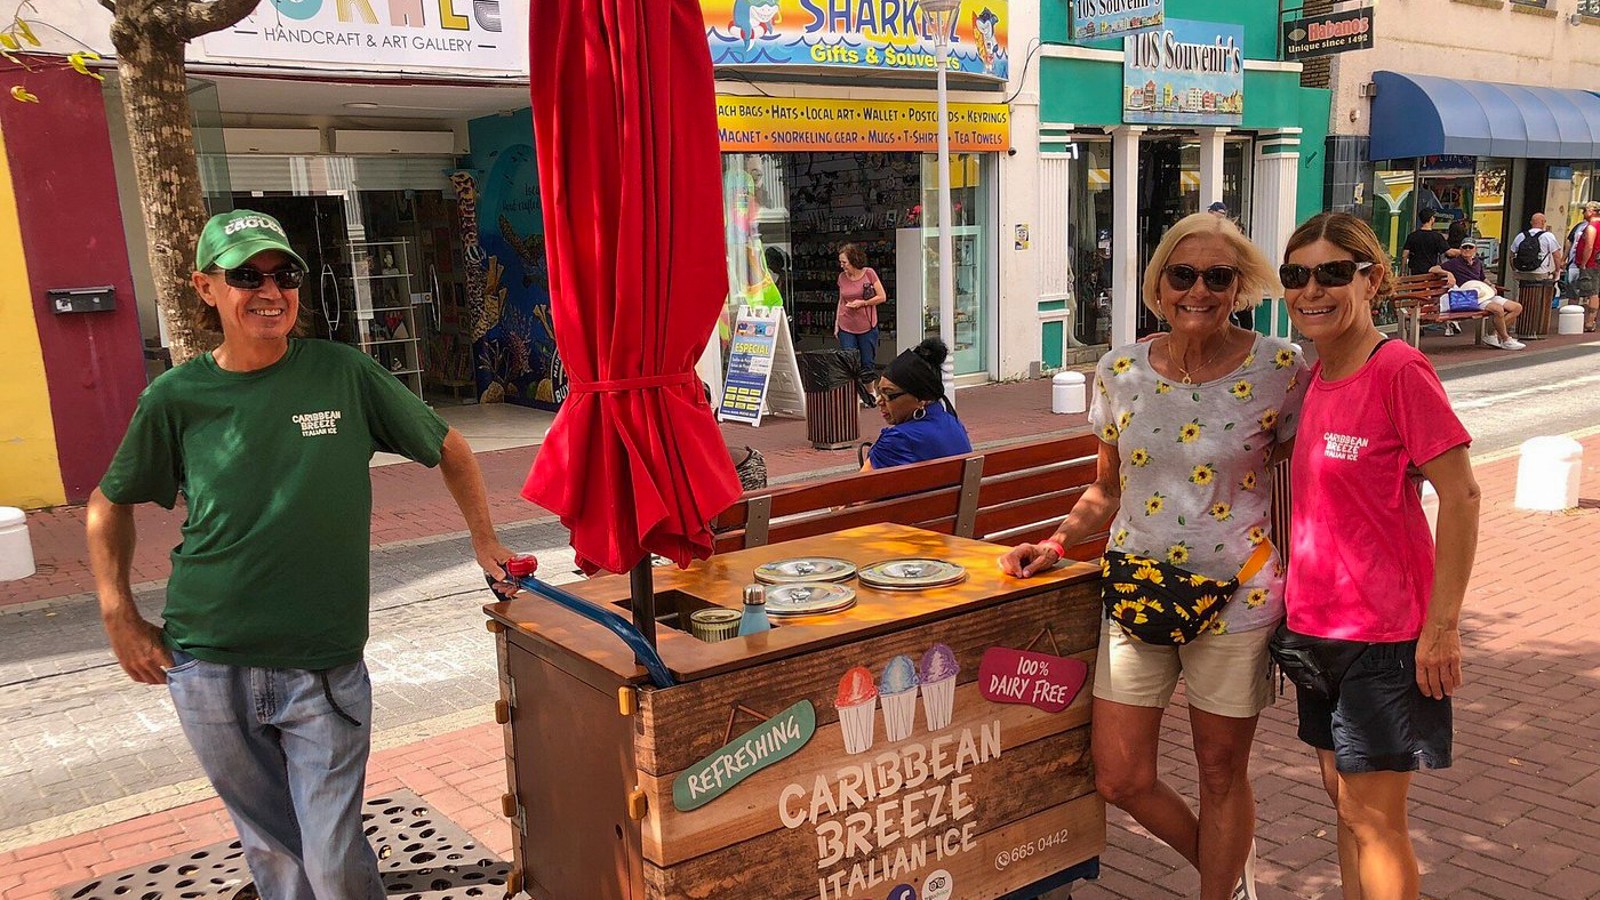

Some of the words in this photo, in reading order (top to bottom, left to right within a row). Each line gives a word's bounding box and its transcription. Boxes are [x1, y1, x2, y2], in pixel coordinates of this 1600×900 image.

[801, 0, 959, 42] SHARKEZ
[1308, 17, 1369, 41] Habanos
[264, 28, 360, 46] HANDCRAFT
[366, 34, 378, 48] &
[382, 36, 408, 48] ART
[412, 36, 472, 52] GALLERY
[1288, 43, 1320, 53] Unique
[1322, 38, 1345, 48] since
[1348, 34, 1368, 44] 1492
[810, 44, 859, 64] Gifts
[865, 47, 879, 65] &
[885, 48, 960, 70] Souvers
[1130, 32, 1160, 69] 10S
[1163, 31, 1240, 74] Souvenir's
[718, 105, 737, 117] ACH
[740, 105, 763, 117] BAGS
[771, 104, 799, 120] HATS
[805, 106, 834, 120] LOCAL
[836, 108, 855, 120] ART
[863, 107, 899, 121] WALLET
[908, 108, 960, 122] POSTCDS
[967, 110, 1007, 123] KEYRINGS
[718, 128, 761, 143] MAGNET
[771, 130, 832, 144] SNORKELING
[834, 131, 858, 144] GEAR
[868, 130, 895, 144] MUGS
[954, 131, 970, 144] TEA
[972, 131, 1003, 145] TOWELS
[735, 342, 769, 355] ESPECIAL
[292, 411, 341, 424] CARIBBEAN
[301, 419, 337, 430] BREEZE
[302, 429, 327, 437] ITALIAN
[1323, 431, 1369, 447] CARIBBEAN
[1325, 449, 1346, 460] ITALIAN
[1347, 453, 1359, 461] ICE
[1326, 441, 1360, 454] BREEZE
[1017, 656, 1049, 677] 100%
[989, 674, 1030, 699] DAIRY
[1032, 679, 1068, 704] FREE
[687, 715, 800, 800] REFRESHING
[778, 720, 1001, 829] CARIBBEAN
[815, 773, 975, 869] BREEZE
[1010, 840, 1035, 863] 665
[1038, 829, 1069, 852] 0442
[818, 839, 926, 900] ITALIAN
[936, 820, 977, 861] ICE
